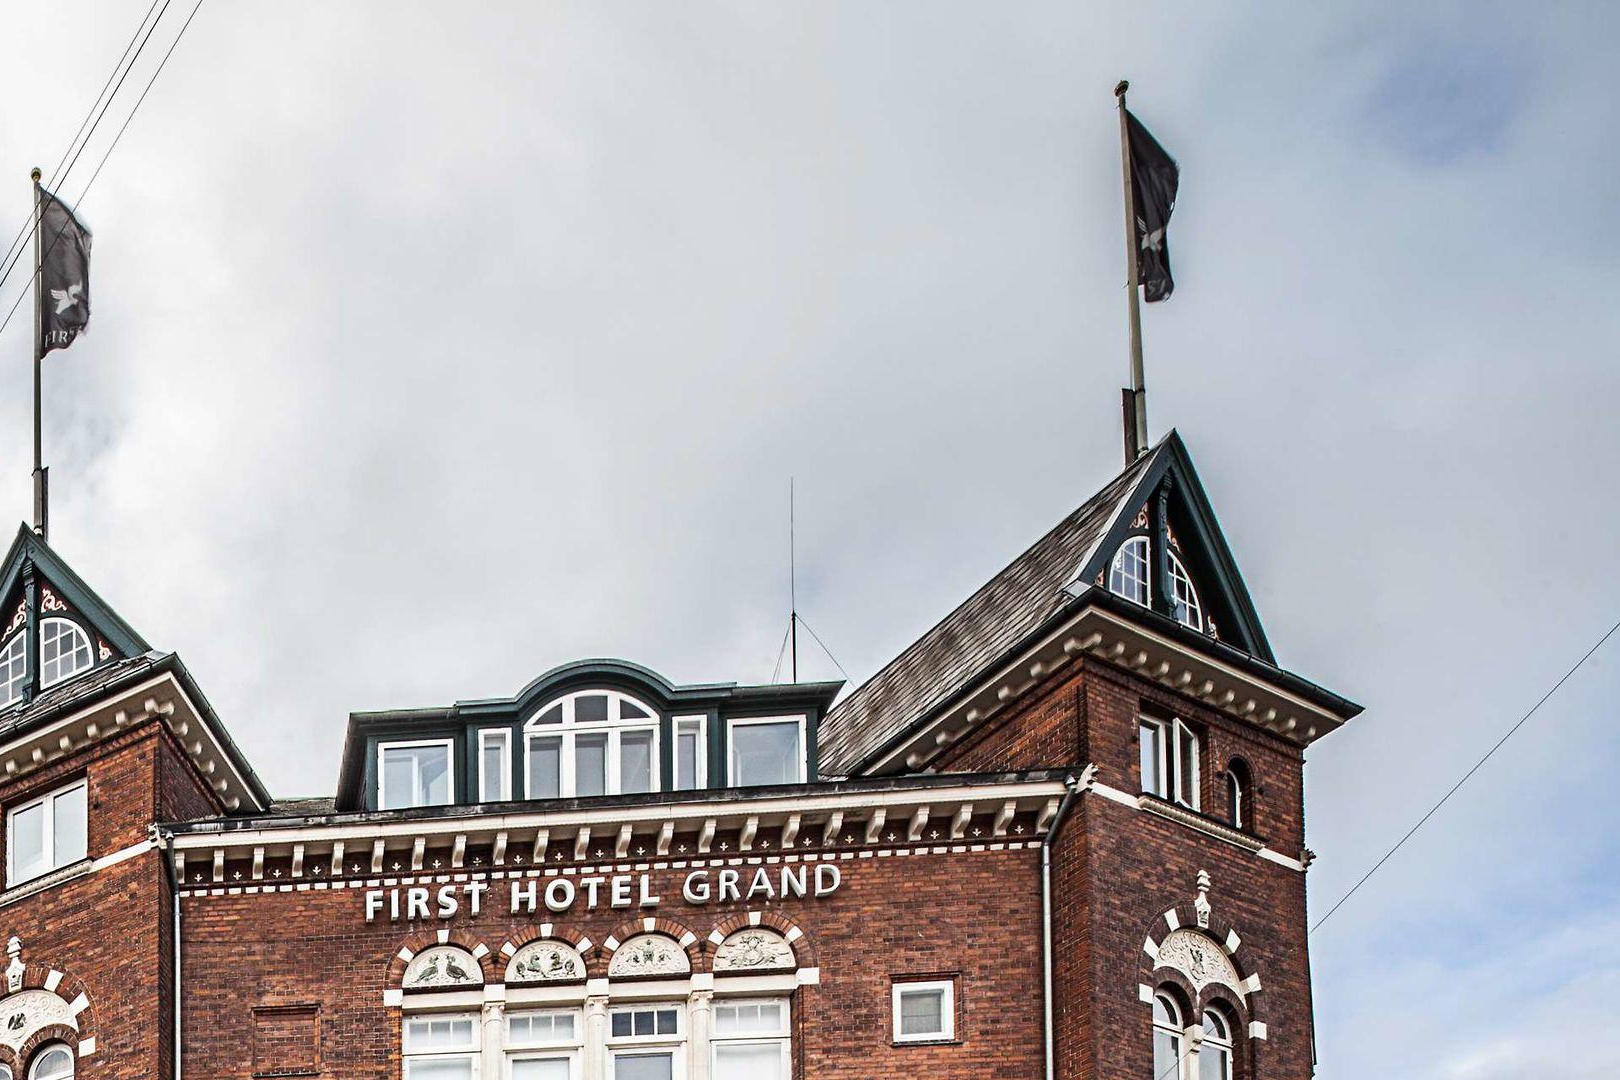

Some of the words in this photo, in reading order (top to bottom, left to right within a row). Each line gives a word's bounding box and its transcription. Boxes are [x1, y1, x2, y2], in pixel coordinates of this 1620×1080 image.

[44, 326, 82, 348] FIR
[366, 881, 487, 922] FIRST
[510, 874, 660, 914] HOTEL
[683, 864, 841, 905] GRAND
